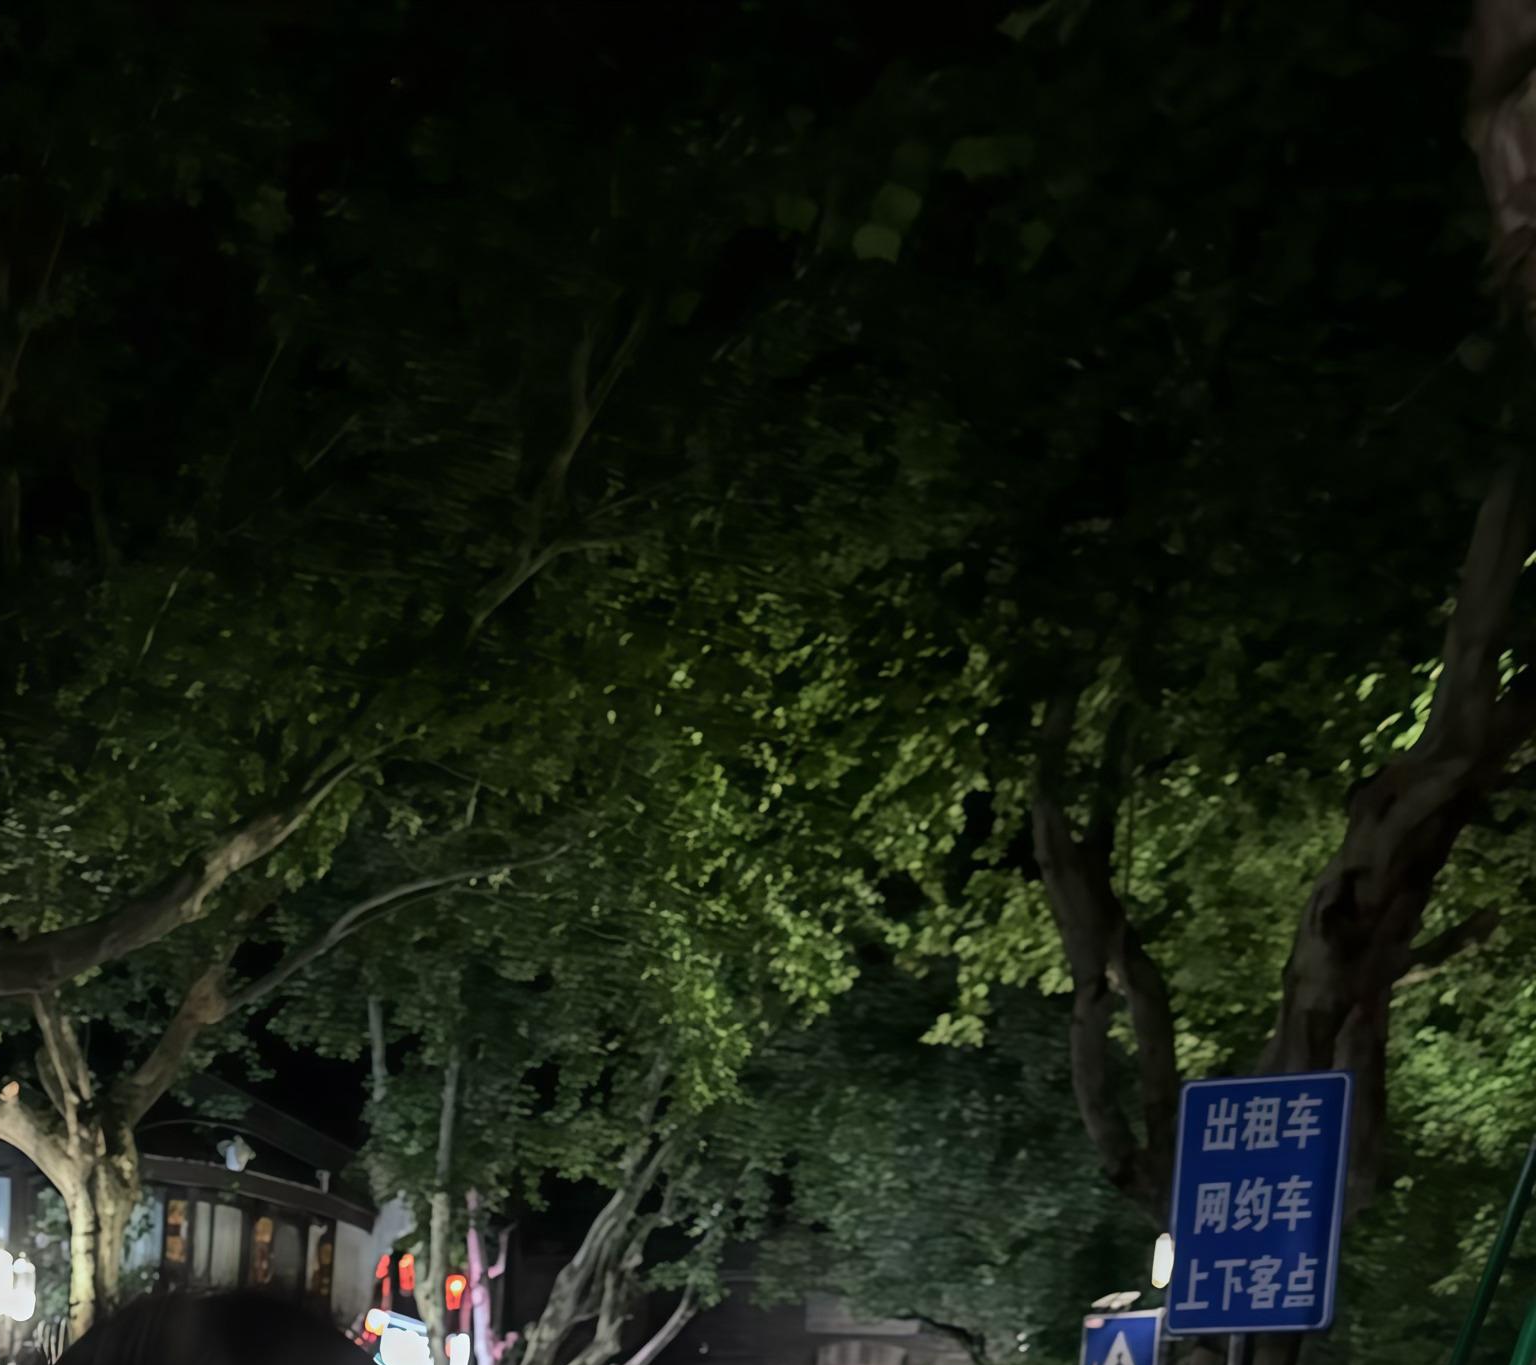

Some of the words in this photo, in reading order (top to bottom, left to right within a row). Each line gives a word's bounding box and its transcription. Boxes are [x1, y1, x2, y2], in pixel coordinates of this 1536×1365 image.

[1204, 1094, 1322, 1151] 出租车
[1195, 1176, 1312, 1234] 网约车
[1175, 1253, 1317, 1310] 上下客点
